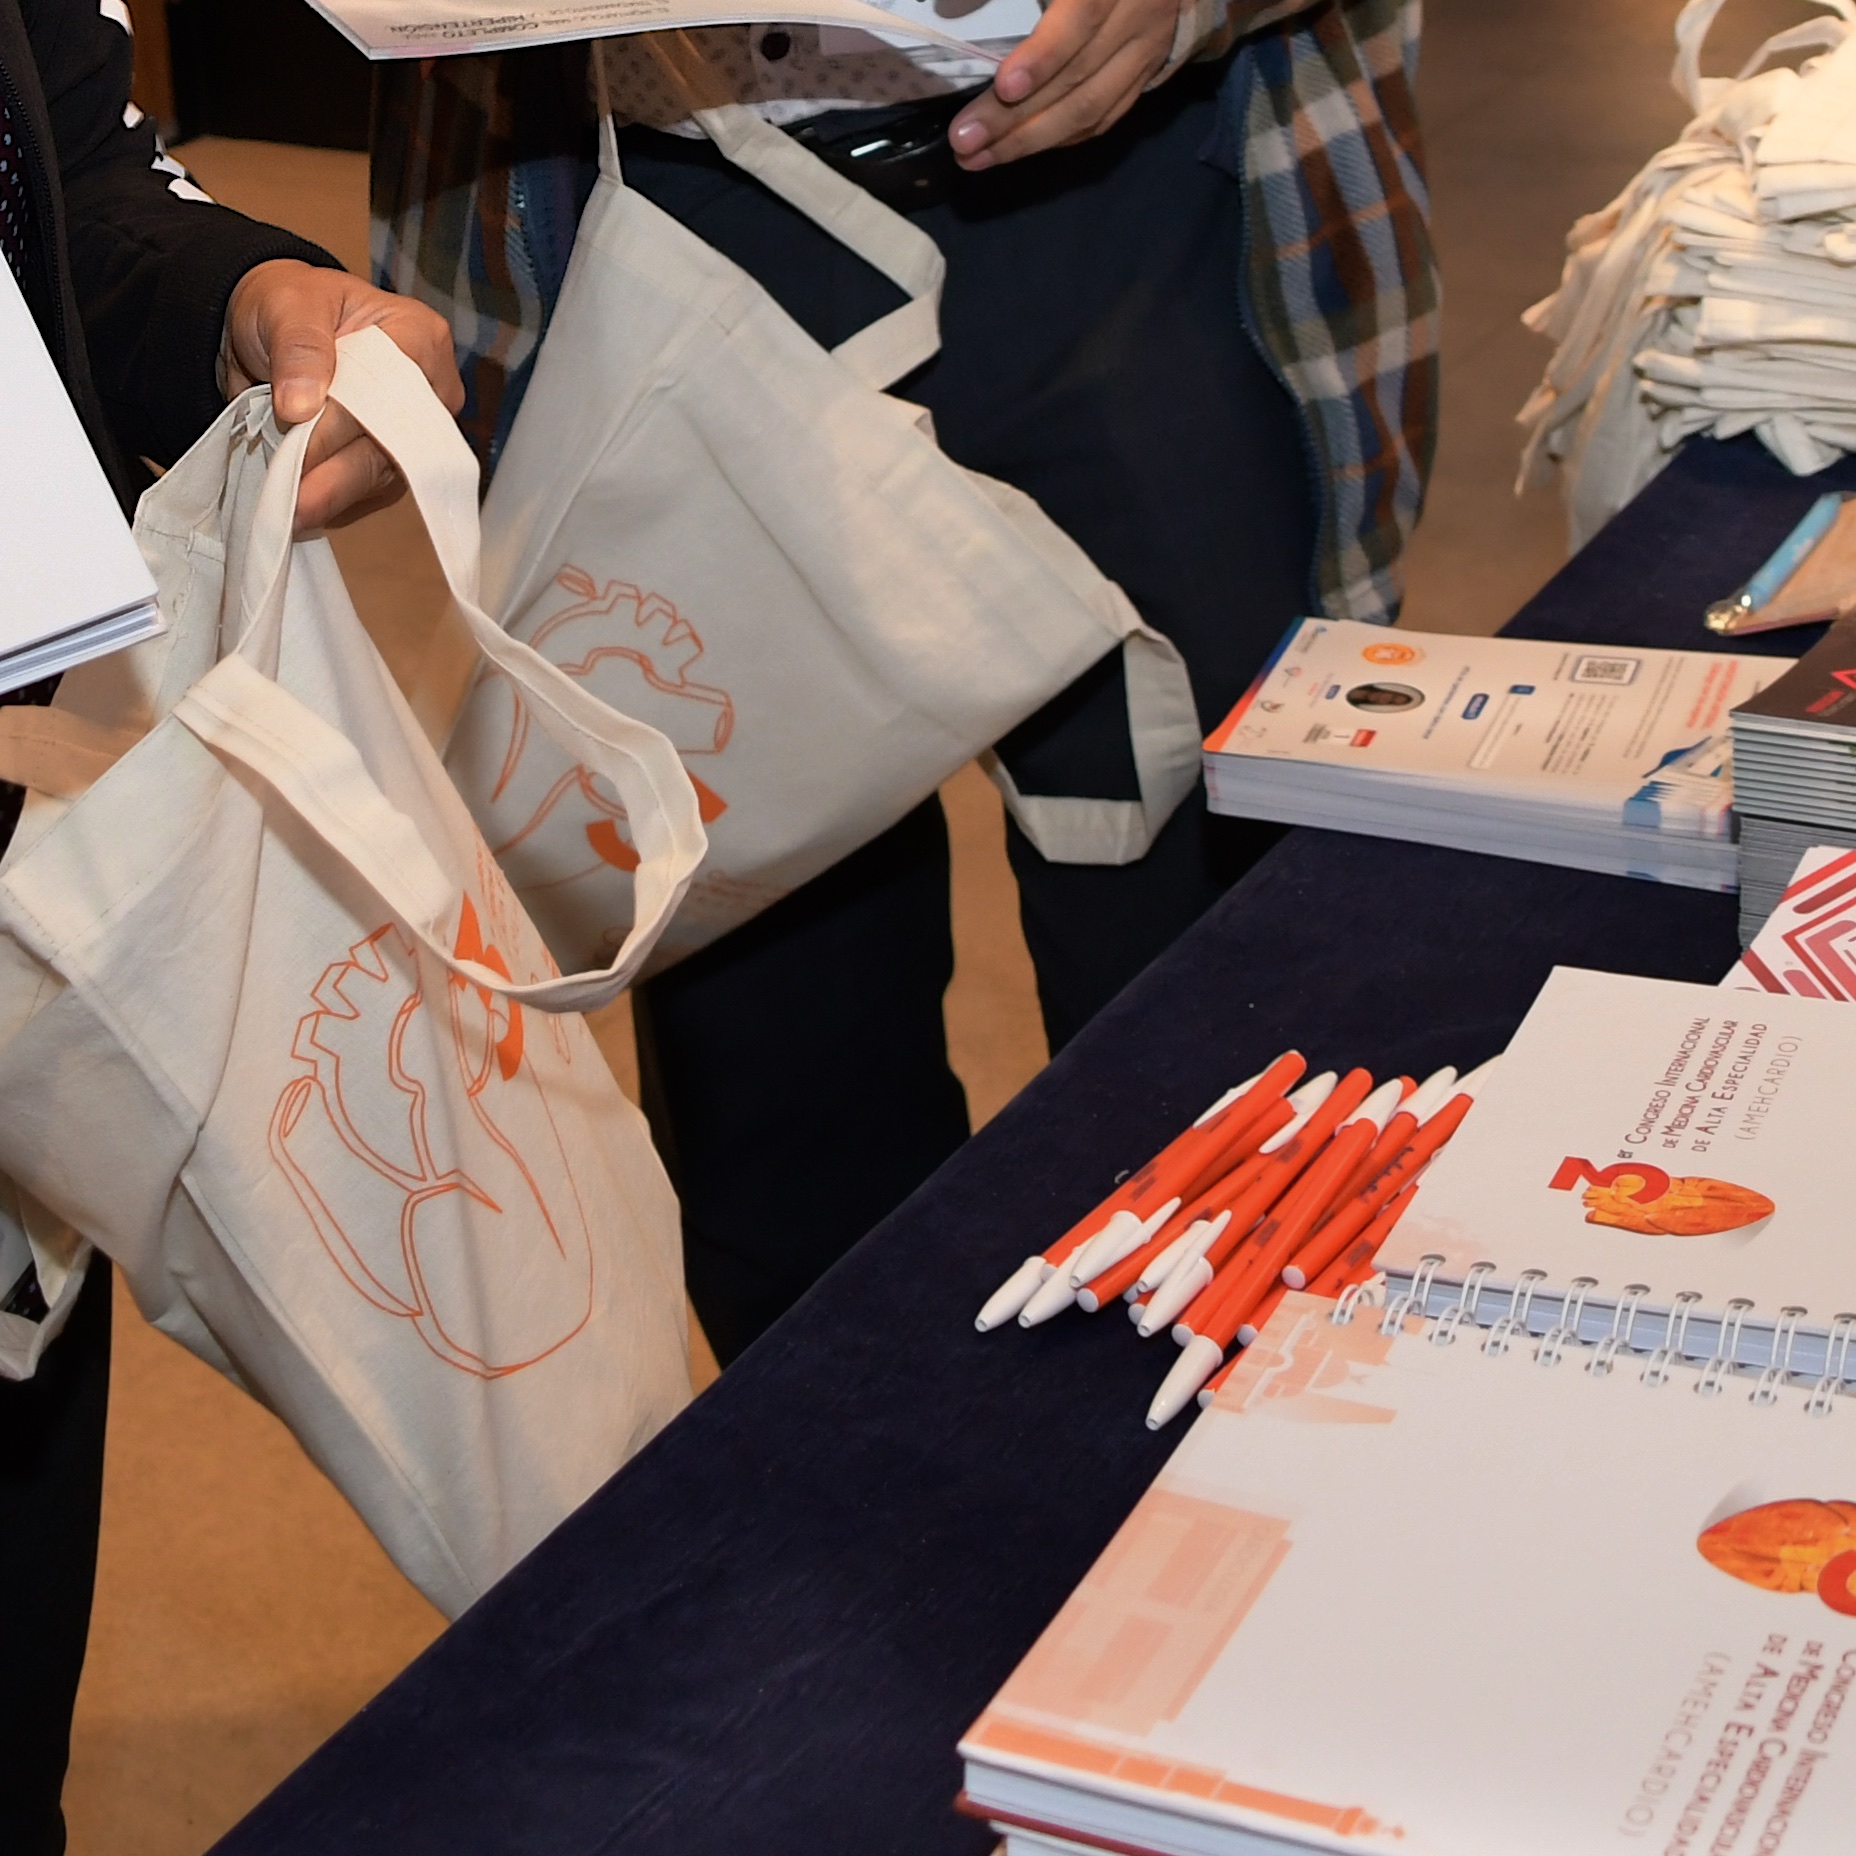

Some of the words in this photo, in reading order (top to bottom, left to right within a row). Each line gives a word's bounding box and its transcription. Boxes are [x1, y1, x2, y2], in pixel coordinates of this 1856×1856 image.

[1624, 1089, 1672, 1145] CONGRESO
[1655, 1017, 1710, 1087] INTERNACIONAL
[1661, 1095, 1702, 1138] MEDICINA
[1685, 1019, 1739, 1093] CARDIOVASCULAR
[1711, 1022, 1768, 1102] ESPECIALIDAD
[1734, 1035, 1803, 1141] (AMEHCARDIO)
[1691, 1139, 1711, 1153] DE
[1695, 1106, 1728, 1137] ALTA
[1762, 1633, 1788, 1656] DE
[1736, 1661, 1780, 1711] ALTA
[1768, 1658, 1825, 1733] MEDICINA
